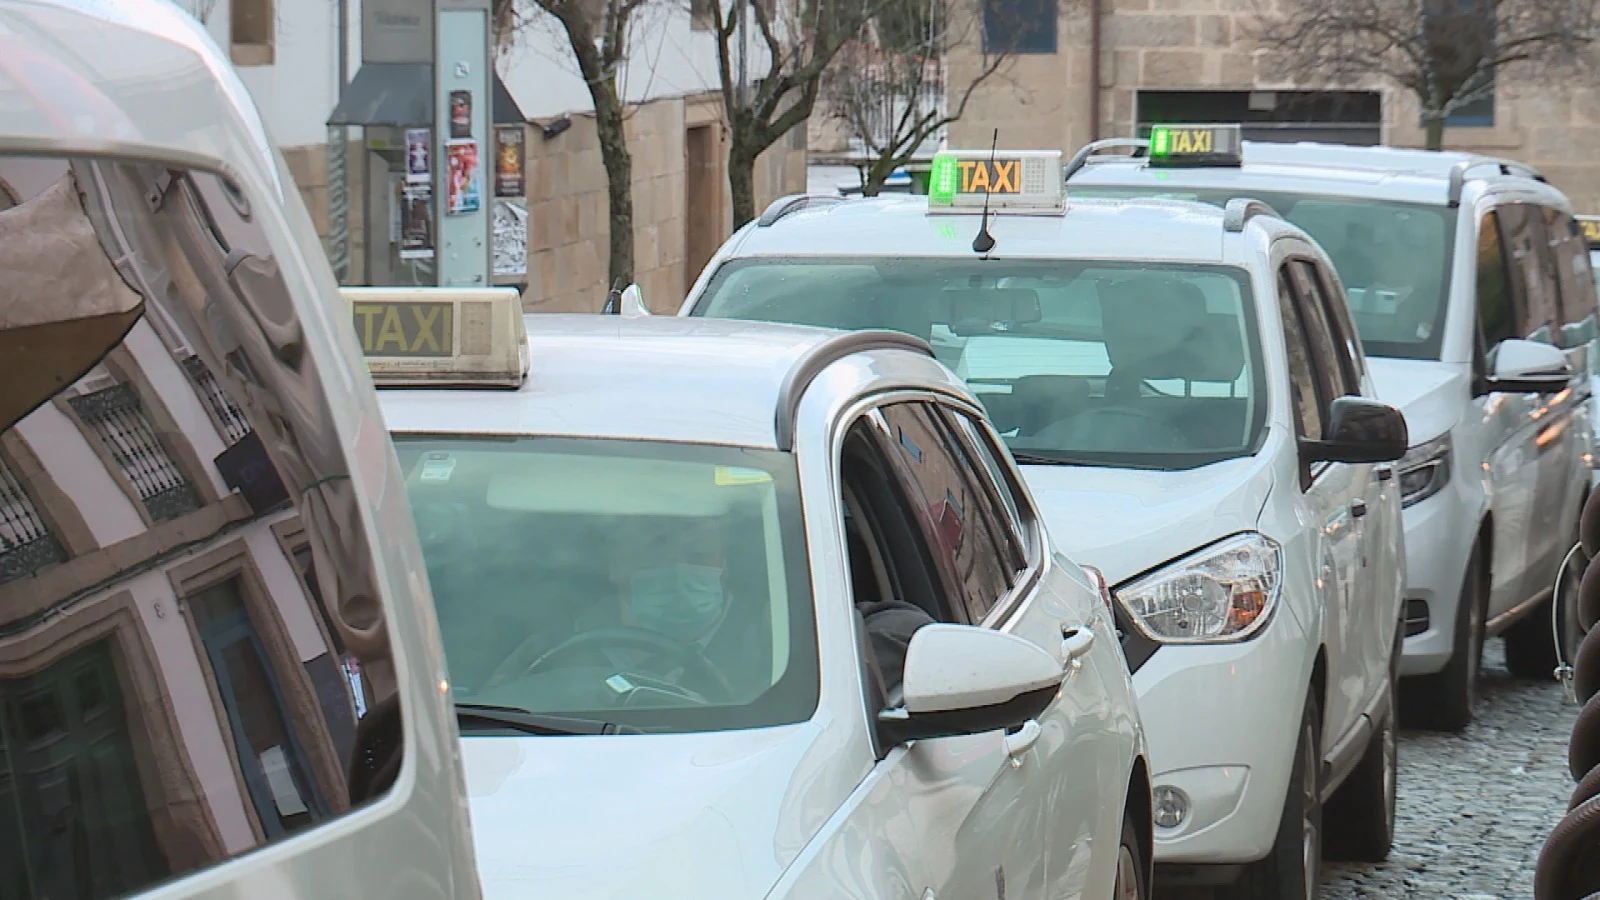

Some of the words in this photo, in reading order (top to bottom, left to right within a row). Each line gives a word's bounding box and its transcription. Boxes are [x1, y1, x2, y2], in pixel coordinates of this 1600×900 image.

[1168, 130, 1212, 152] TAXI
[957, 161, 1021, 193] TAXI
[355, 305, 453, 352] TAXI
